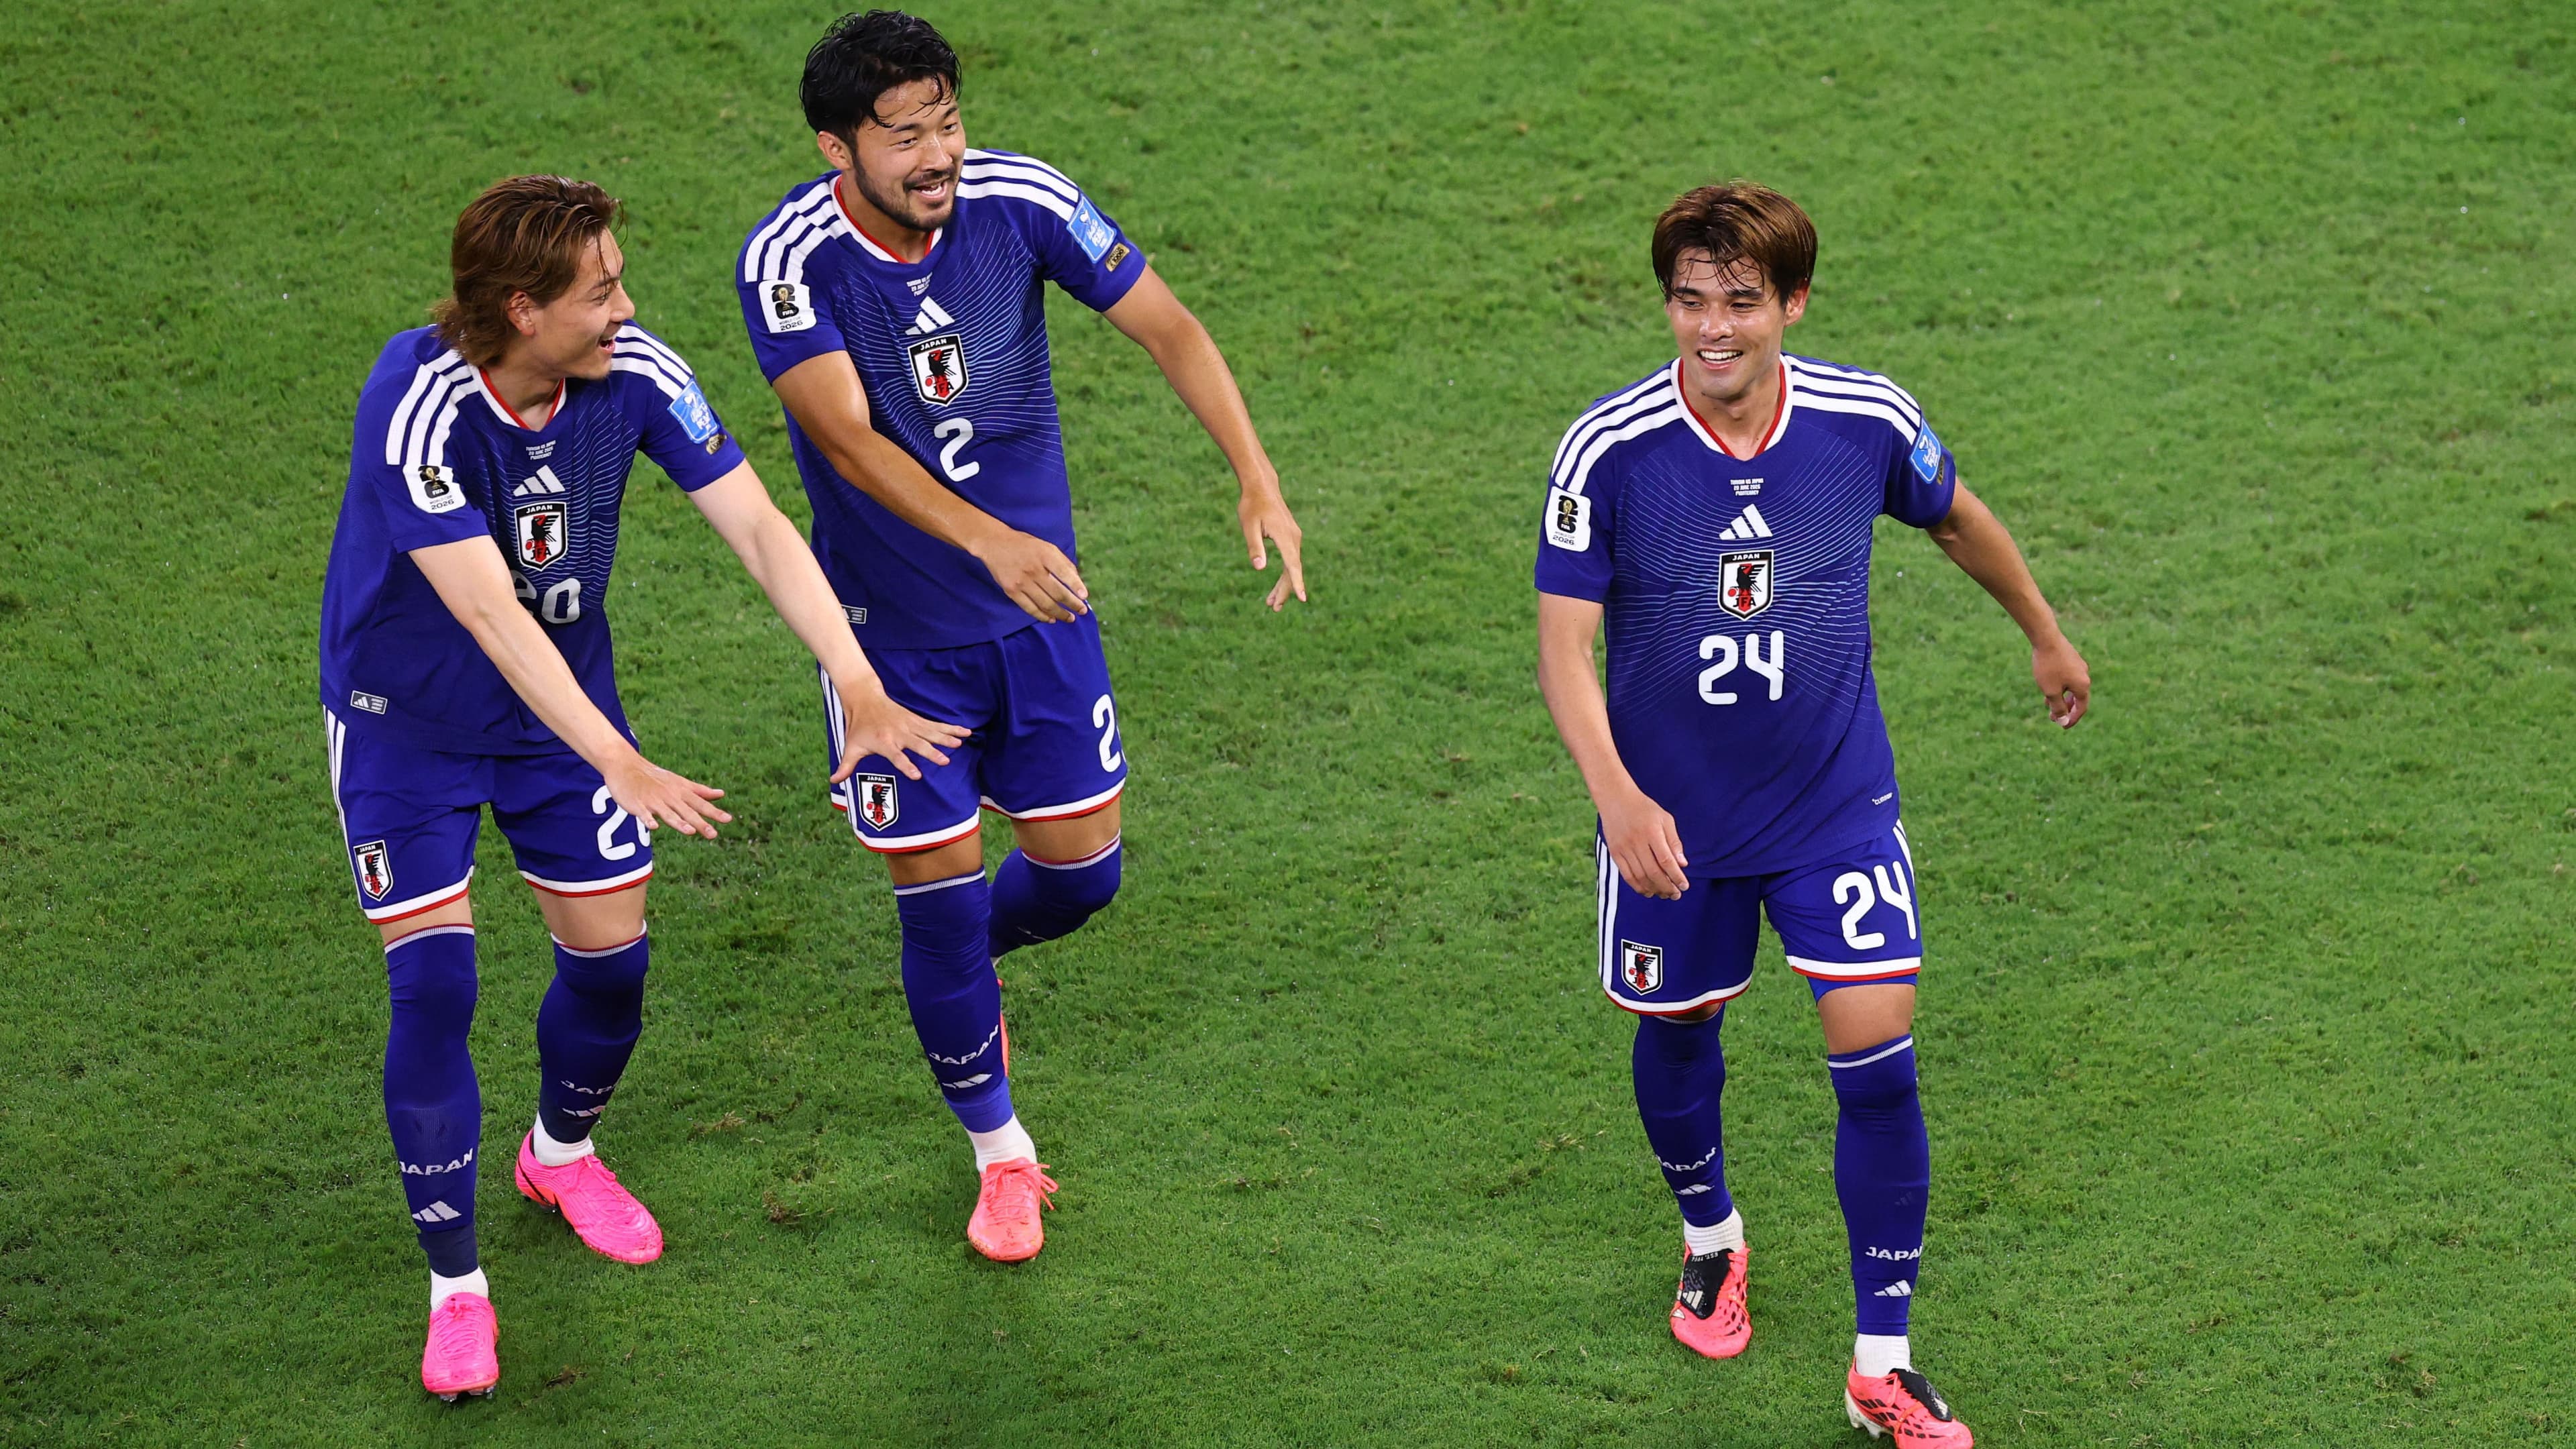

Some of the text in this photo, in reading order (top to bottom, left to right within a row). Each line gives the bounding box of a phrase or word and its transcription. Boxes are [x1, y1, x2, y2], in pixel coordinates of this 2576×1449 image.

[780, 320, 804, 331] 2026
[920, 338, 947, 351] JAPAN
[933, 381, 954, 396] JFA
[934, 418, 979, 482] 2
[431, 499, 455, 510] 2026
[526, 504, 553, 514] JAPAN
[1552, 535, 1575, 545] 2026
[531, 547, 552, 560] JFA
[1732, 553, 1760, 561] JAPAN
[1733, 596, 1756, 608] JFA
[1699, 630, 1784, 705] 24
[1093, 694, 1121, 773] 2
[360, 845, 376, 853] JAPAN
[1833, 861, 1917, 950] 24
[1631, 944, 1652, 953] JAPAN
[928, 1024, 999, 1065] JAPAN
